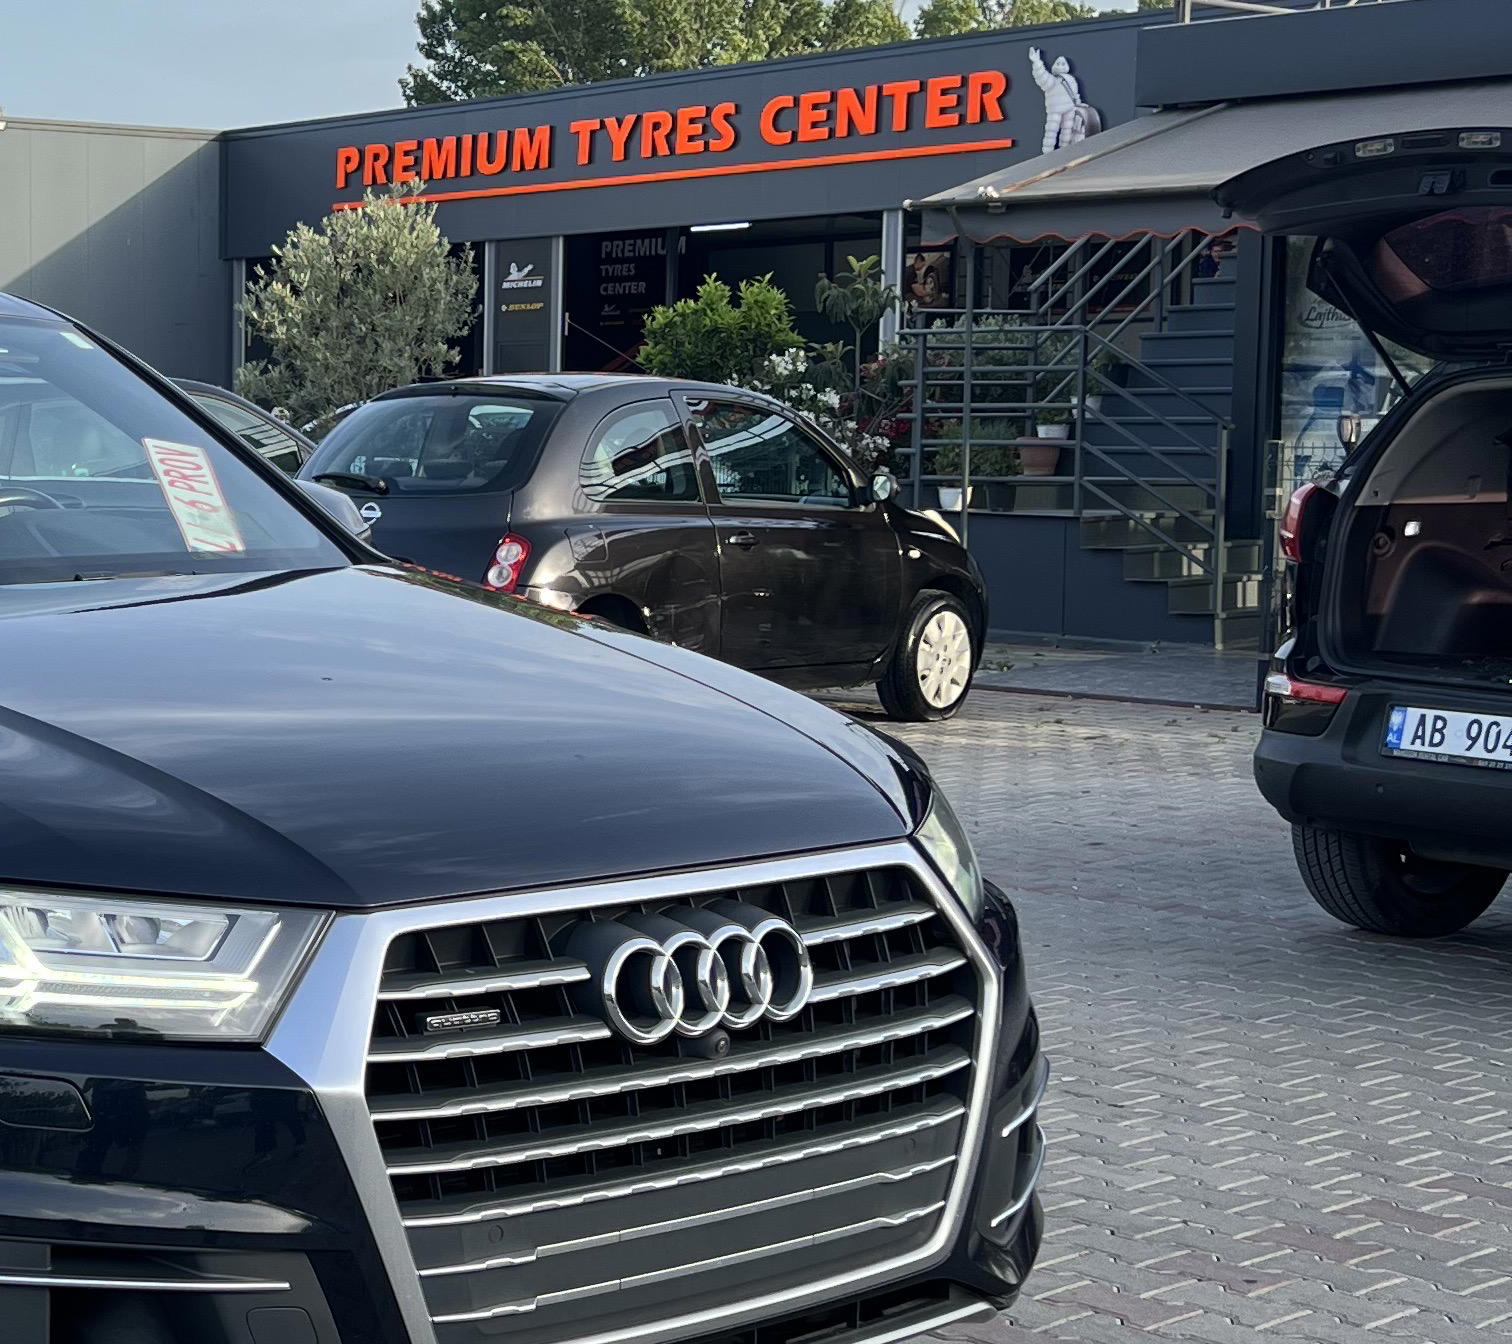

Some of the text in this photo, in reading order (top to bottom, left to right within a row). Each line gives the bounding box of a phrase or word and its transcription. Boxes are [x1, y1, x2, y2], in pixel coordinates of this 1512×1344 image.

[336, 70, 1007, 189] PREMIUM TYRES CENTER
[600, 263, 636, 277] TYRES
[501, 279, 543, 289] MICHELIN
[600, 281, 646, 296] CENTER
[151, 444, 214, 496] PROV
[1410, 713, 1448, 748] AB
